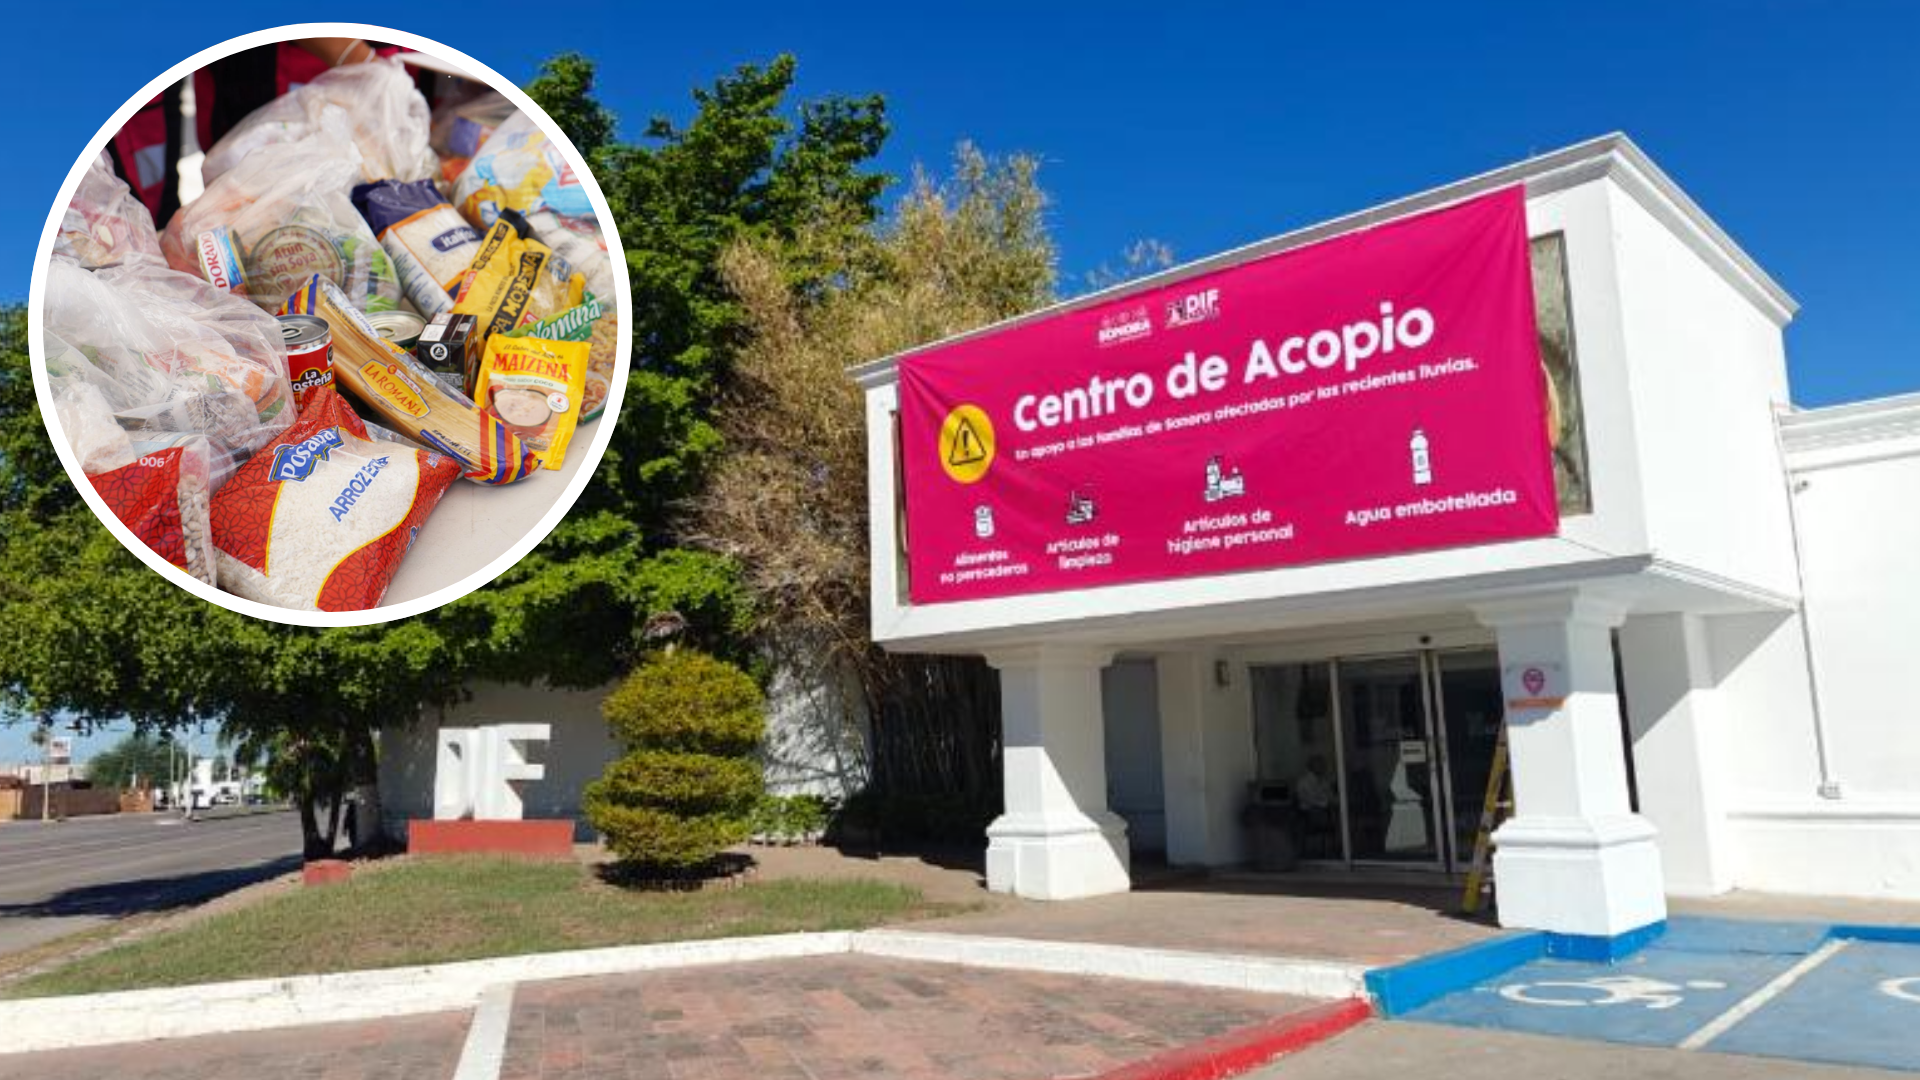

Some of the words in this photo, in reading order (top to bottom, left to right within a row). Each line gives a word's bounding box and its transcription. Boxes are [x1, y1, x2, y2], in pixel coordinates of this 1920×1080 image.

[269, 262, 288, 278] sin
[288, 251, 317, 270] Soya
[274, 242, 304, 261] Atún
[1185, 289, 1219, 315] DIF
[304, 369, 317, 381] La
[491, 353, 570, 383] MAIZENA
[1013, 372, 1154, 432] Centro
[1166, 351, 1229, 399] de
[1243, 300, 1435, 384] Acopio
[292, 371, 332, 391] osteña
[364, 364, 377, 380] LA
[377, 375, 422, 416] ROMANA
[1031, 441, 1066, 459] apoyo
[1066, 439, 1076, 449] a
[1077, 434, 1095, 448] las
[1096, 425, 1143, 444] familias
[1146, 419, 1163, 434] de
[1165, 411, 1211, 431] Sonora
[1214, 396, 1286, 421] afectadas
[1288, 389, 1315, 408] por
[1317, 384, 1340, 400] las
[1342, 367, 1417, 394] recientes
[1419, 356, 1479, 379] lluvias.
[280, 430, 337, 478] Posada
[328, 471, 373, 523] ARROZ
[1345, 508, 1391, 527] Agua
[1395, 487, 1517, 517] embotellada
[1251, 508, 1272, 523] de
[1102, 533, 1121, 548] de
[1168, 537, 1221, 555] higiene
[1224, 524, 1294, 550] personal
[955, 550, 1009, 566] Alimentos
[1058, 552, 1114, 570] limpieza
[940, 572, 954, 585] no
[955, 563, 1029, 584] perecederos
[434, 723, 551, 821] DIF
